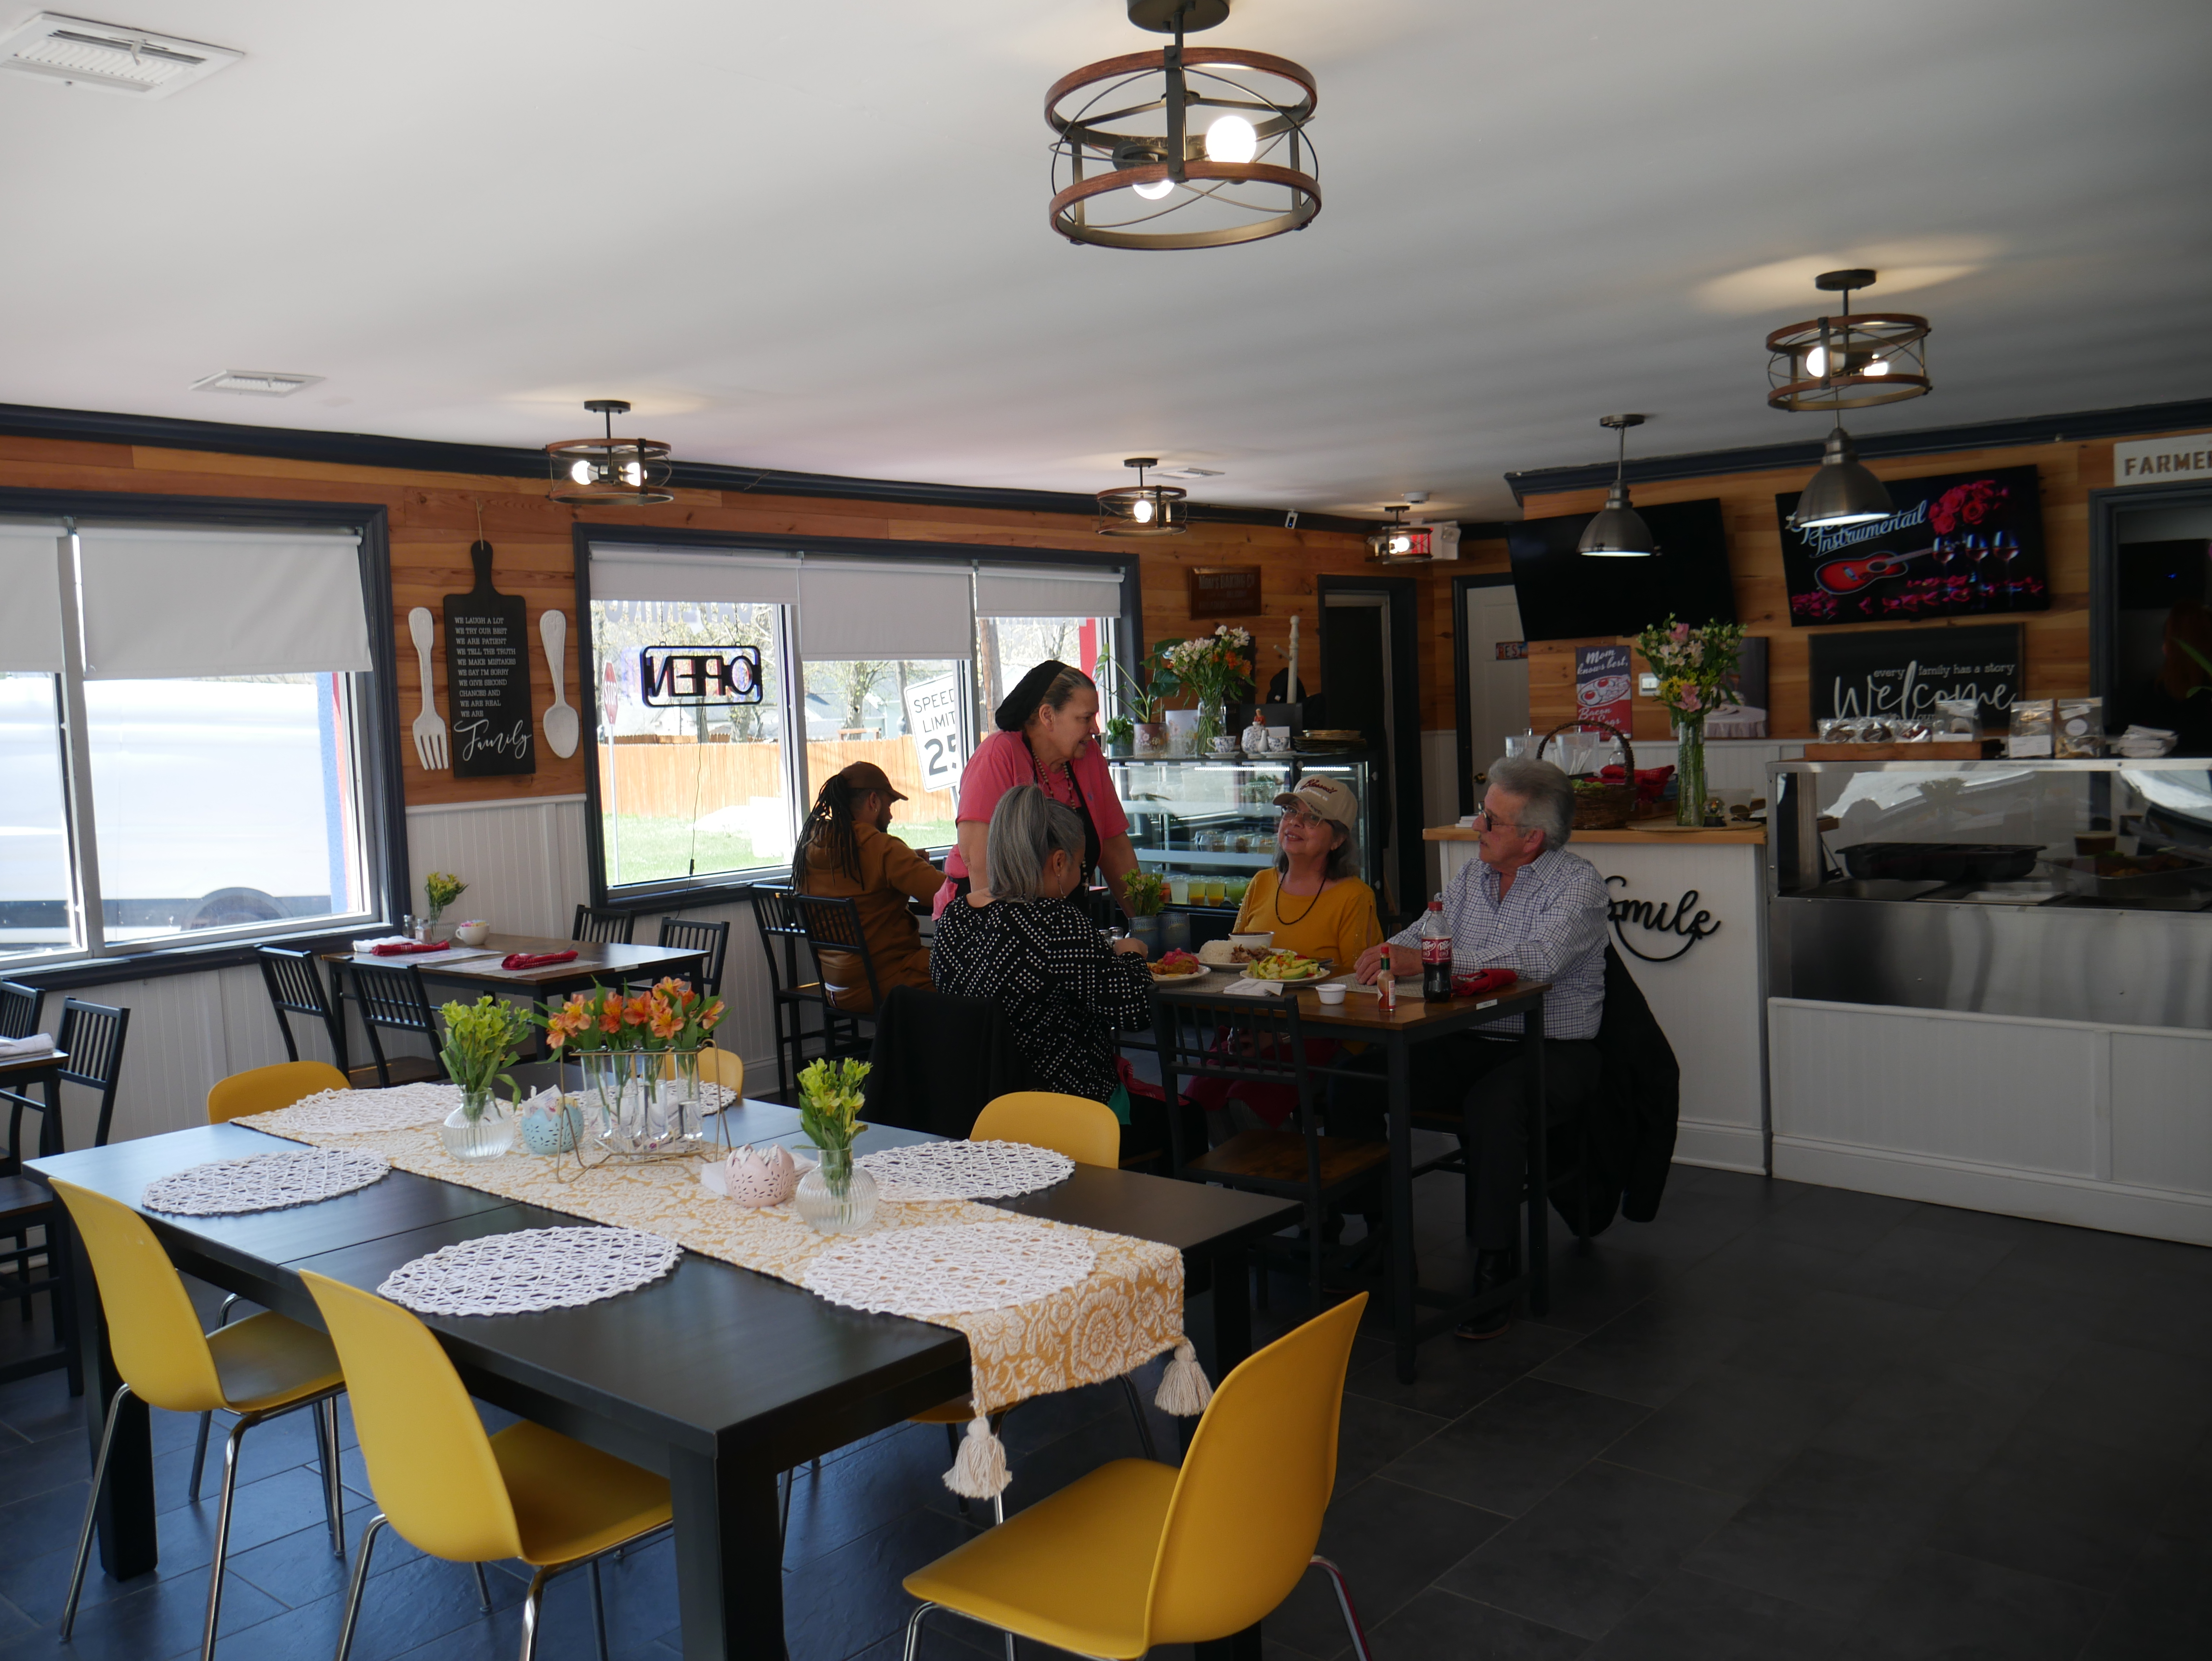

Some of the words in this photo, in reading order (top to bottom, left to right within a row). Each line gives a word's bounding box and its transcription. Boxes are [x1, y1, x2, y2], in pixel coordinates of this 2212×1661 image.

[1585, 649, 1616, 664] Mom
[1577, 662, 1606, 675] knows
[1873, 669, 1907, 680] every
[1918, 664, 1951, 678] family
[1952, 664, 1972, 674] has
[1984, 662, 2015, 675] story
[604, 680, 617, 706] STOP
[1833, 660, 2018, 720] Welcome
[1578, 707, 1612, 721] Bacon
[454, 719, 532, 761] Family
